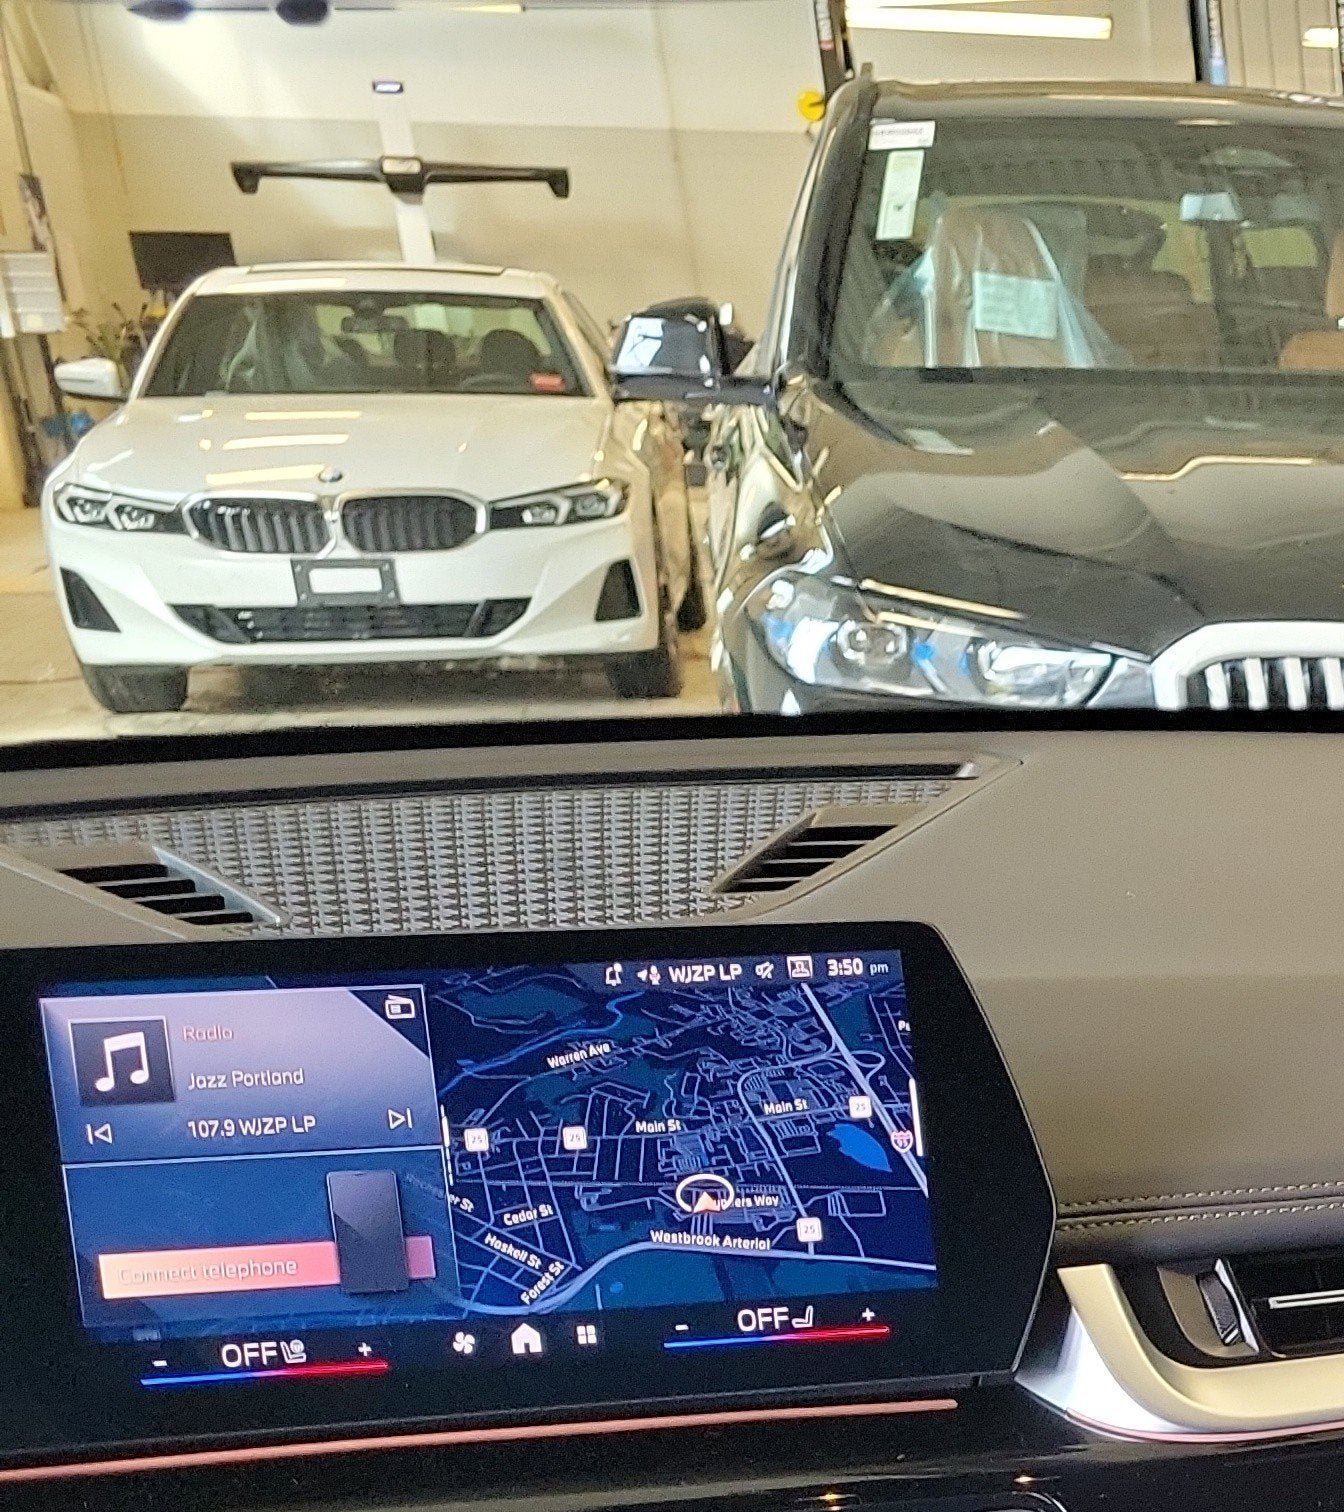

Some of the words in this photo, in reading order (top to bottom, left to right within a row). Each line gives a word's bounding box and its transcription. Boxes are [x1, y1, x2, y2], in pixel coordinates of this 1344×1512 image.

[668, 965, 716, 983] WJZP
[719, 963, 743, 981] LP
[827, 957, 863, 976] 3:50
[869, 961, 889, 975] pm
[183, 1024, 234, 1042] Radio
[546, 1049, 588, 1069] Warren
[588, 1041, 612, 1059] Ave
[188, 1072, 227, 1091] Jazz
[232, 1068, 304, 1086] Portland
[763, 1100, 792, 1115] Main
[794, 1098, 809, 1112] St
[187, 1118, 235, 1139] 107.9
[238, 1116, 288, 1136] WJZP
[291, 1114, 317, 1133] LP
[635, 1119, 665, 1132] Main
[667, 1118, 682, 1131] St
[753, 1194, 779, 1207] Way
[503, 1207, 537, 1226] Cedar
[538, 1204, 554, 1218] St
[484, 1232, 527, 1263] Haskell
[527, 1253, 542, 1269] St
[650, 1230, 721, 1248] Westbrook
[723, 1234, 771, 1250] Arterial
[119, 1264, 198, 1286] Connect
[201, 1258, 299, 1282] telephone
[520, 1275, 552, 1305] Forest
[549, 1261, 565, 1279] St
[737, 1306, 789, 1332] OFF
[221, 1342, 277, 1368] OFF
